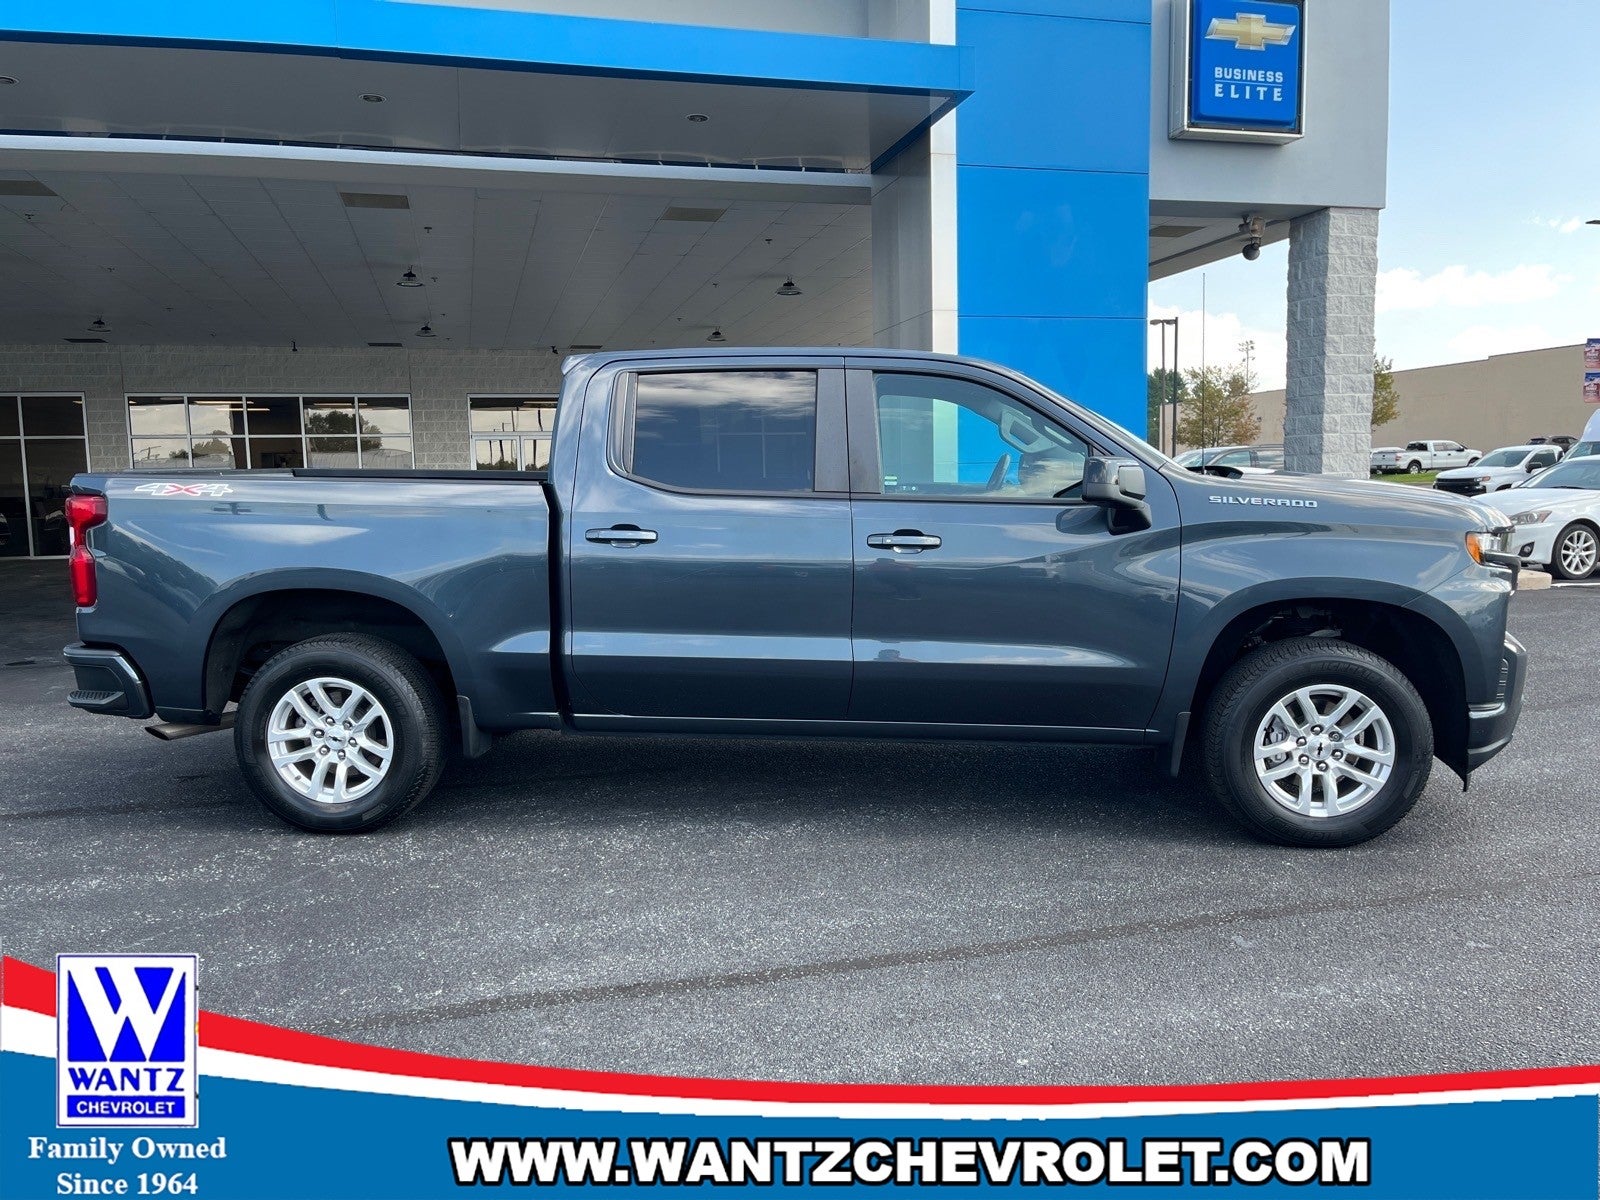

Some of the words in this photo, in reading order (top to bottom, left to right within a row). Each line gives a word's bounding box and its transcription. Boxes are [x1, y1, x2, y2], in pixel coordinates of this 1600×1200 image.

[1215, 67, 1284, 83] BUSINESS
[1214, 84, 1283, 101] ELITE
[134, 482, 234, 497] 4X4
[1208, 495, 1318, 508] SILVERADO
